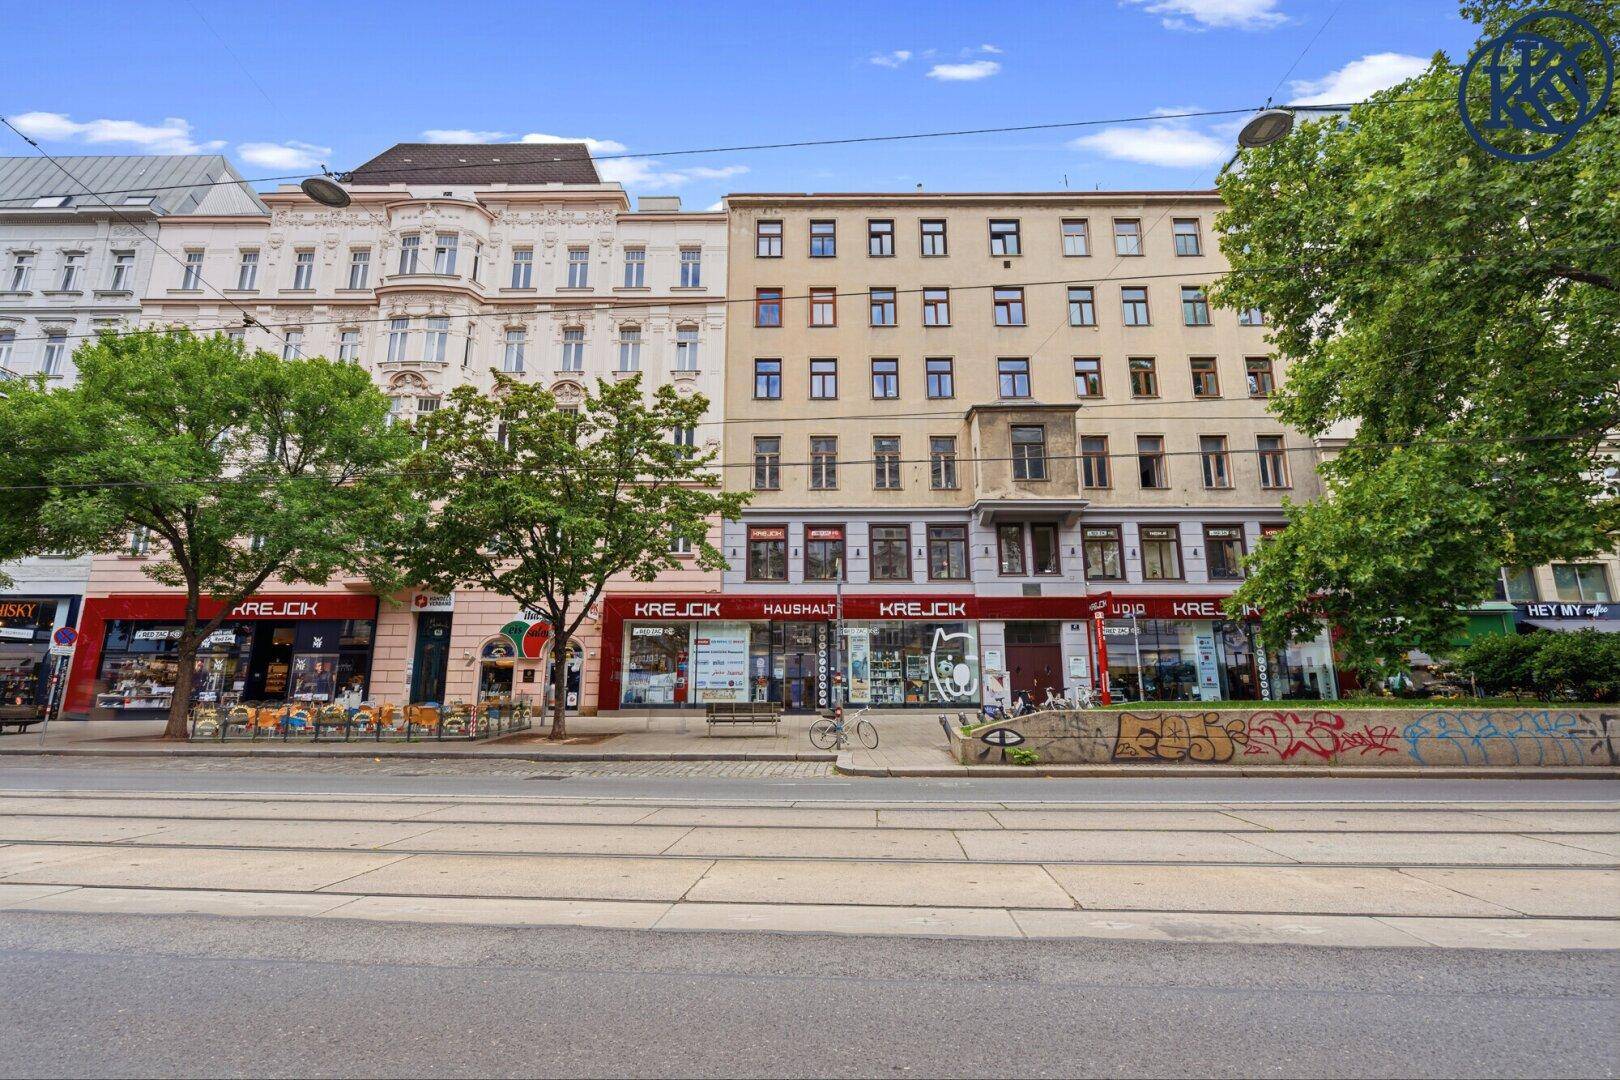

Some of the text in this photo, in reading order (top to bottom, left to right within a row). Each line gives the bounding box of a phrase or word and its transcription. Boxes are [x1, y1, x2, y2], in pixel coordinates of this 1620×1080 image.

[232, 602, 318, 616] KREJCIK
[634, 602, 721, 616] KREJCIK
[763, 604, 836, 615] HAUSHALT
[880, 602, 966, 616] KREJCIK
[1112, 603, 1146, 614] UDIO
[1527, 604, 1609, 617] HEY MY coffee
[508, 626, 522, 635] eis
